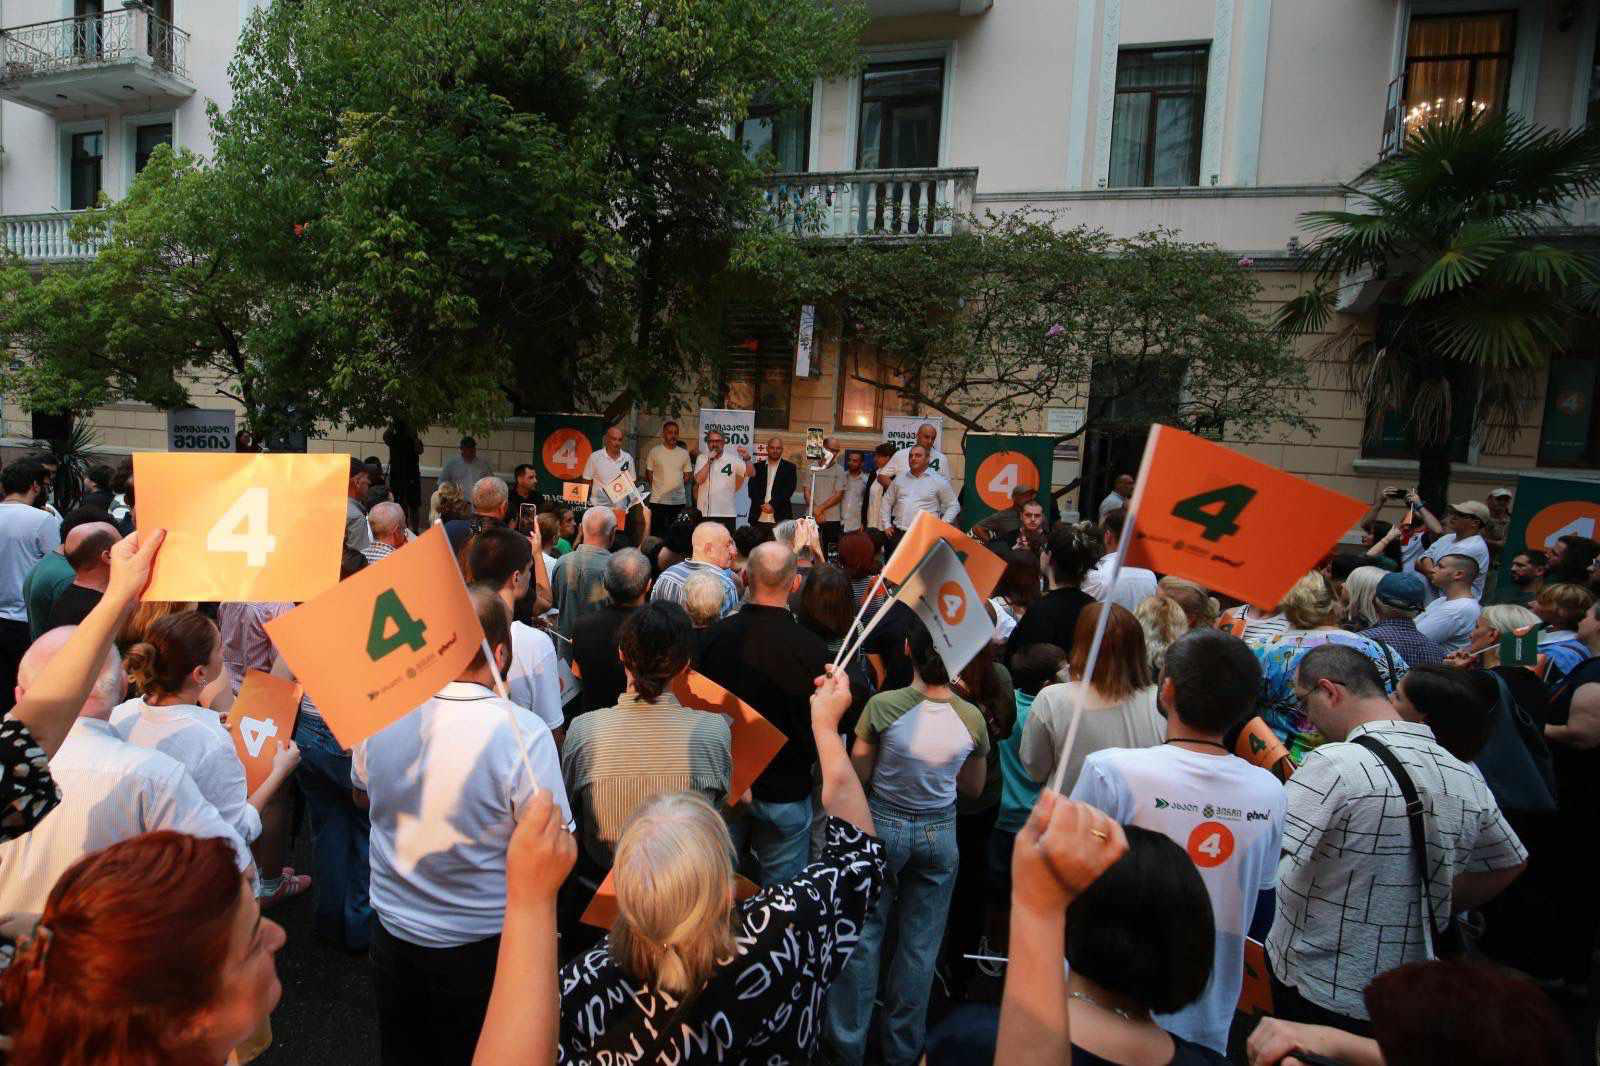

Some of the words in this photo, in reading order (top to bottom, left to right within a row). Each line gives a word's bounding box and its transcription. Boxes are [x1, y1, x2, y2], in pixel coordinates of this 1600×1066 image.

[174, 435, 231, 449] შენია
[552, 437, 578, 470] 4
[720, 464, 733, 477] 4
[928, 458, 940, 472] 4
[988, 463, 1019, 500] 4
[207, 487, 277, 567] 4
[1170, 484, 1258, 543] 4
[365, 587, 428, 662] 4
[240, 716, 278, 758] 4
[1249, 732, 1266, 753] 4
[1198, 832, 1222, 859] 4
